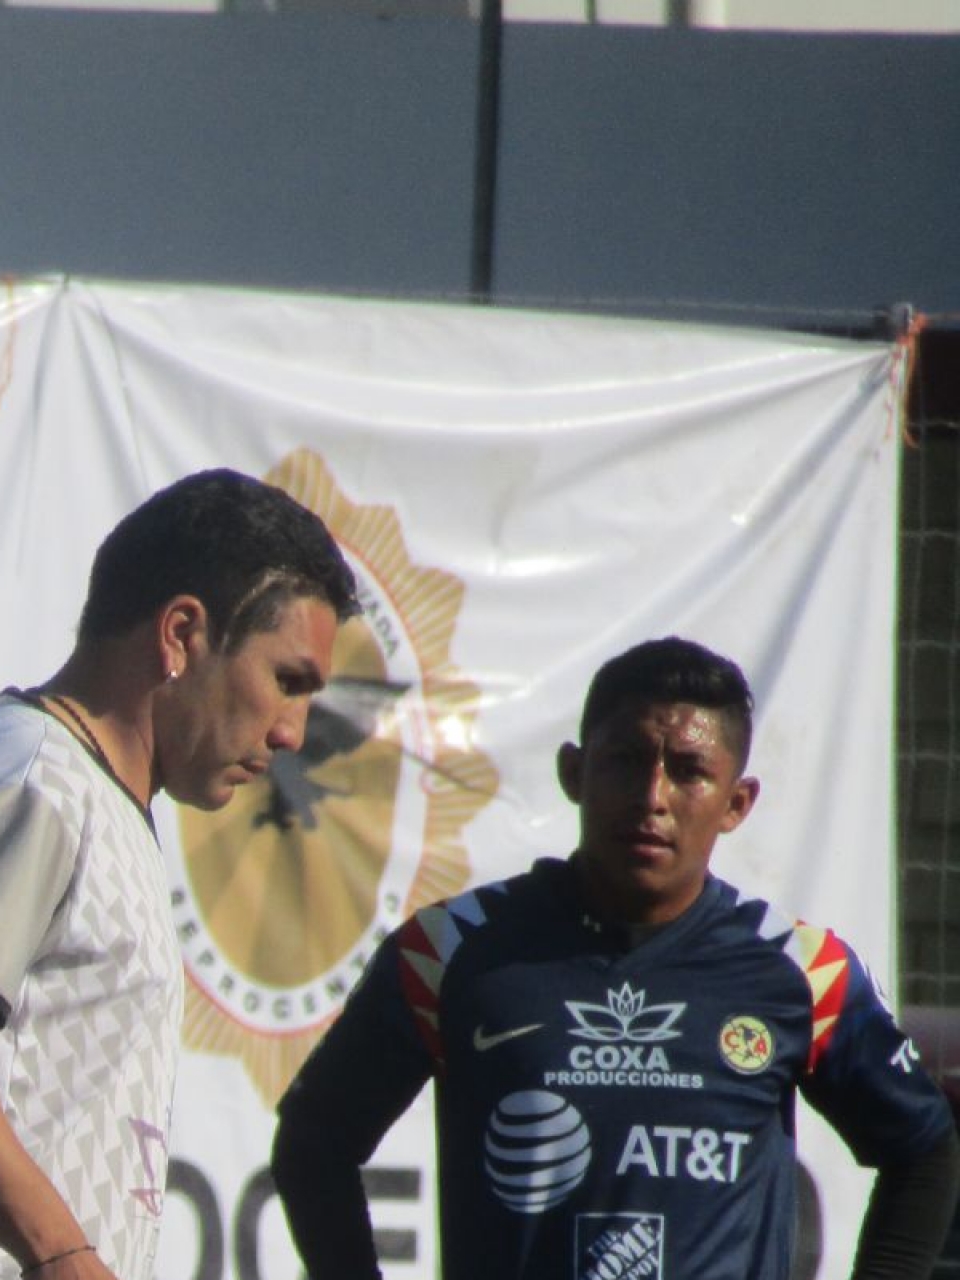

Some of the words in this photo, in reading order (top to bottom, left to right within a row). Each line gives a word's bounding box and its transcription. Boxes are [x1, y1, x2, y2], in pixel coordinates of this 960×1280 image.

[569, 1045, 670, 1071] COXA
[543, 1071, 705, 1089] PRODUCCIONES
[616, 1124, 752, 1184] AT&T
